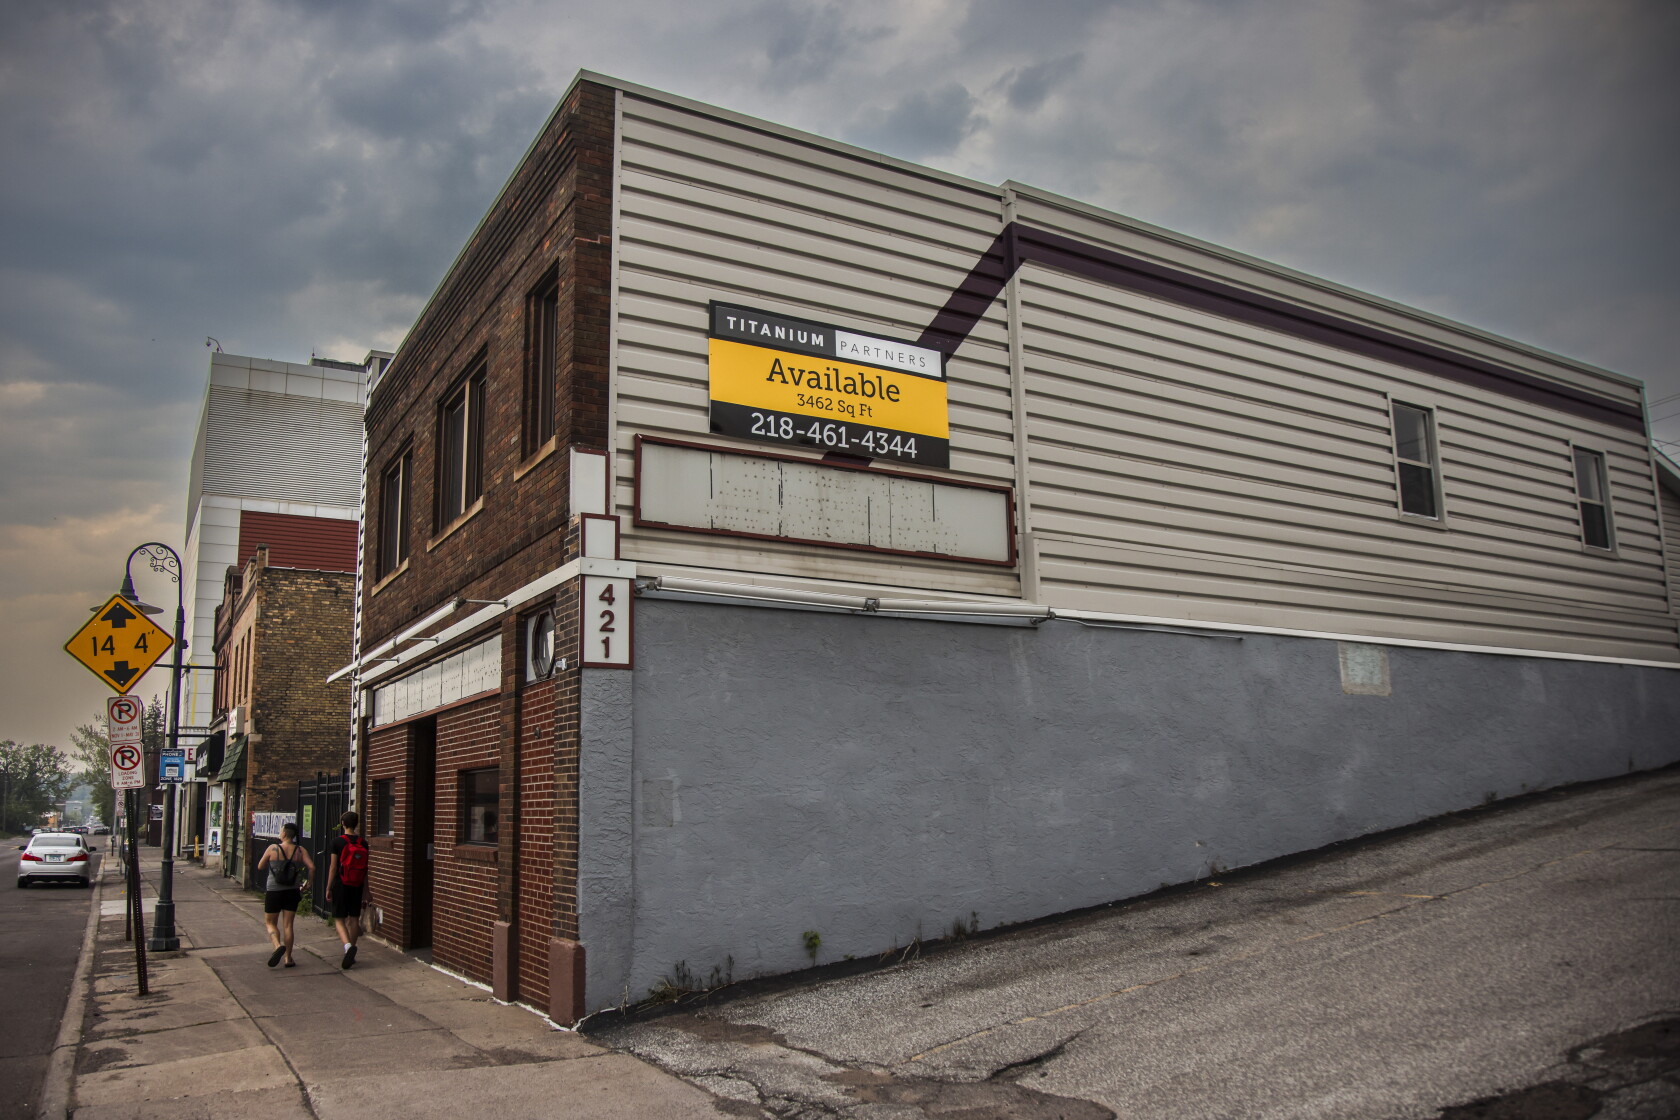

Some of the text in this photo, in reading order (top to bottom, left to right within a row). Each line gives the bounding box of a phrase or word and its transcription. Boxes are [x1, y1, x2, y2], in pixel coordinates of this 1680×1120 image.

[726, 315, 927, 368] TITANIUM PARTNERS
[766, 358, 901, 403] Available
[797, 393, 873, 418] 3462 Sq Ft
[751, 412, 918, 459] 218-461-4344
[598, 583, 616, 659] 421
